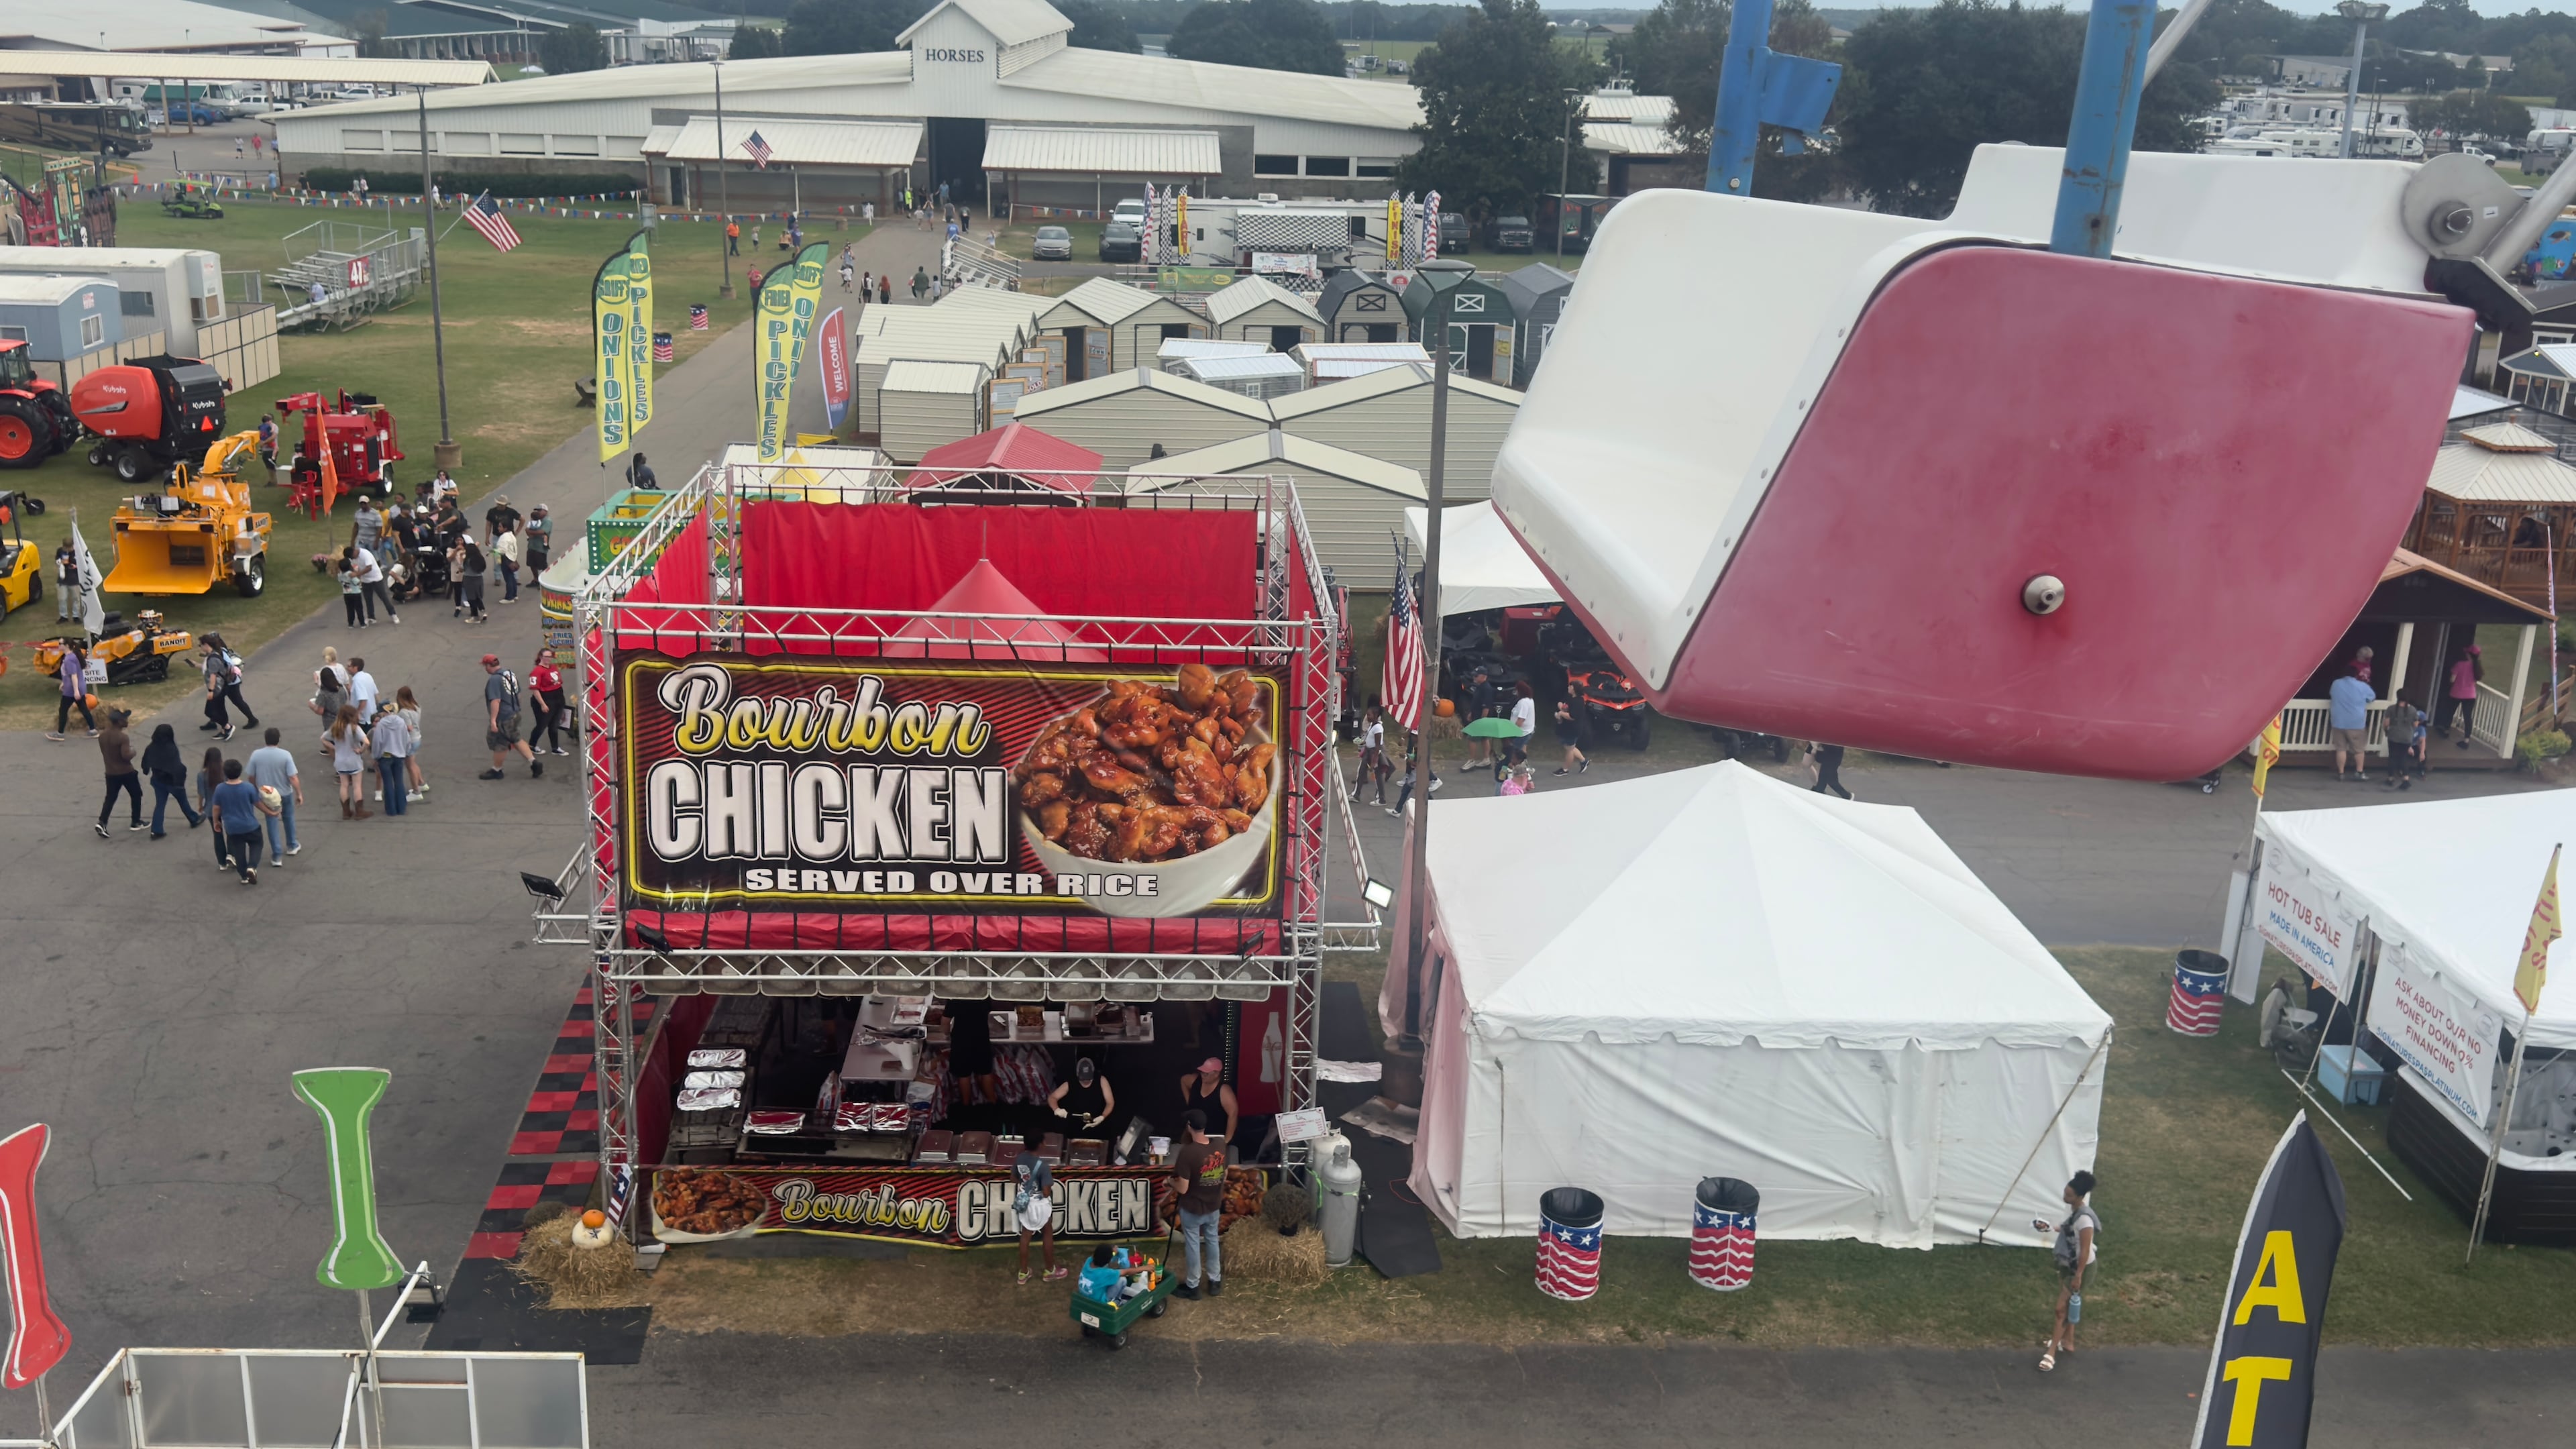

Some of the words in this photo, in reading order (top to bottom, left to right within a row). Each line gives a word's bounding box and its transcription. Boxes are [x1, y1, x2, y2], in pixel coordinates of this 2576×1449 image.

[926, 49, 984, 62] HORSES
[1389, 203, 1399, 259] FINISH
[631, 287, 648, 422] PICKLES
[790, 298, 814, 385] ONIO
[828, 336, 844, 392] WELCOME
[102, 384, 127, 394] Kubota
[192, 400, 215, 409] Kubota
[602, 313, 623, 445] ONIONS
[761, 319, 788, 458] PICKLES
[160, 638, 186, 648] BANDIT
[657, 662, 990, 757] Bourbon
[645, 758, 1008, 863] CHICKEN
[746, 867, 915, 894] SERVED
[929, 871, 1043, 896] OVER
[1056, 873, 1159, 897] RICE
[2268, 881, 2290, 908] HOT
[2292, 898, 2312, 926] TUB
[2314, 915, 2342, 949] SALE
[2269, 910, 2290, 934] MADE
[2291, 926, 2300, 941] IN
[2300, 937, 2335, 969] AMERICA
[2258, 924, 2338, 994] SIGNATURESPASPLATINUM.COM
[2395, 977, 2413, 998] ASK
[2413, 992, 2445, 1023] ABOUT
[2446, 1018, 2466, 1042] OUR
[2468, 1036, 2481, 1055] NO
[2396, 996, 2426, 1029] MONEY
[2428, 1023, 2457, 1056] DOWN
[2375, 1026, 2478, 1121] SIGNATURESPASPLATINUM.COM
[2406, 1025, 2456, 1074] FINANCING
[771, 1178, 951, 1233] Bourbon
[956, 1177, 1150, 1241] CHCKEN
